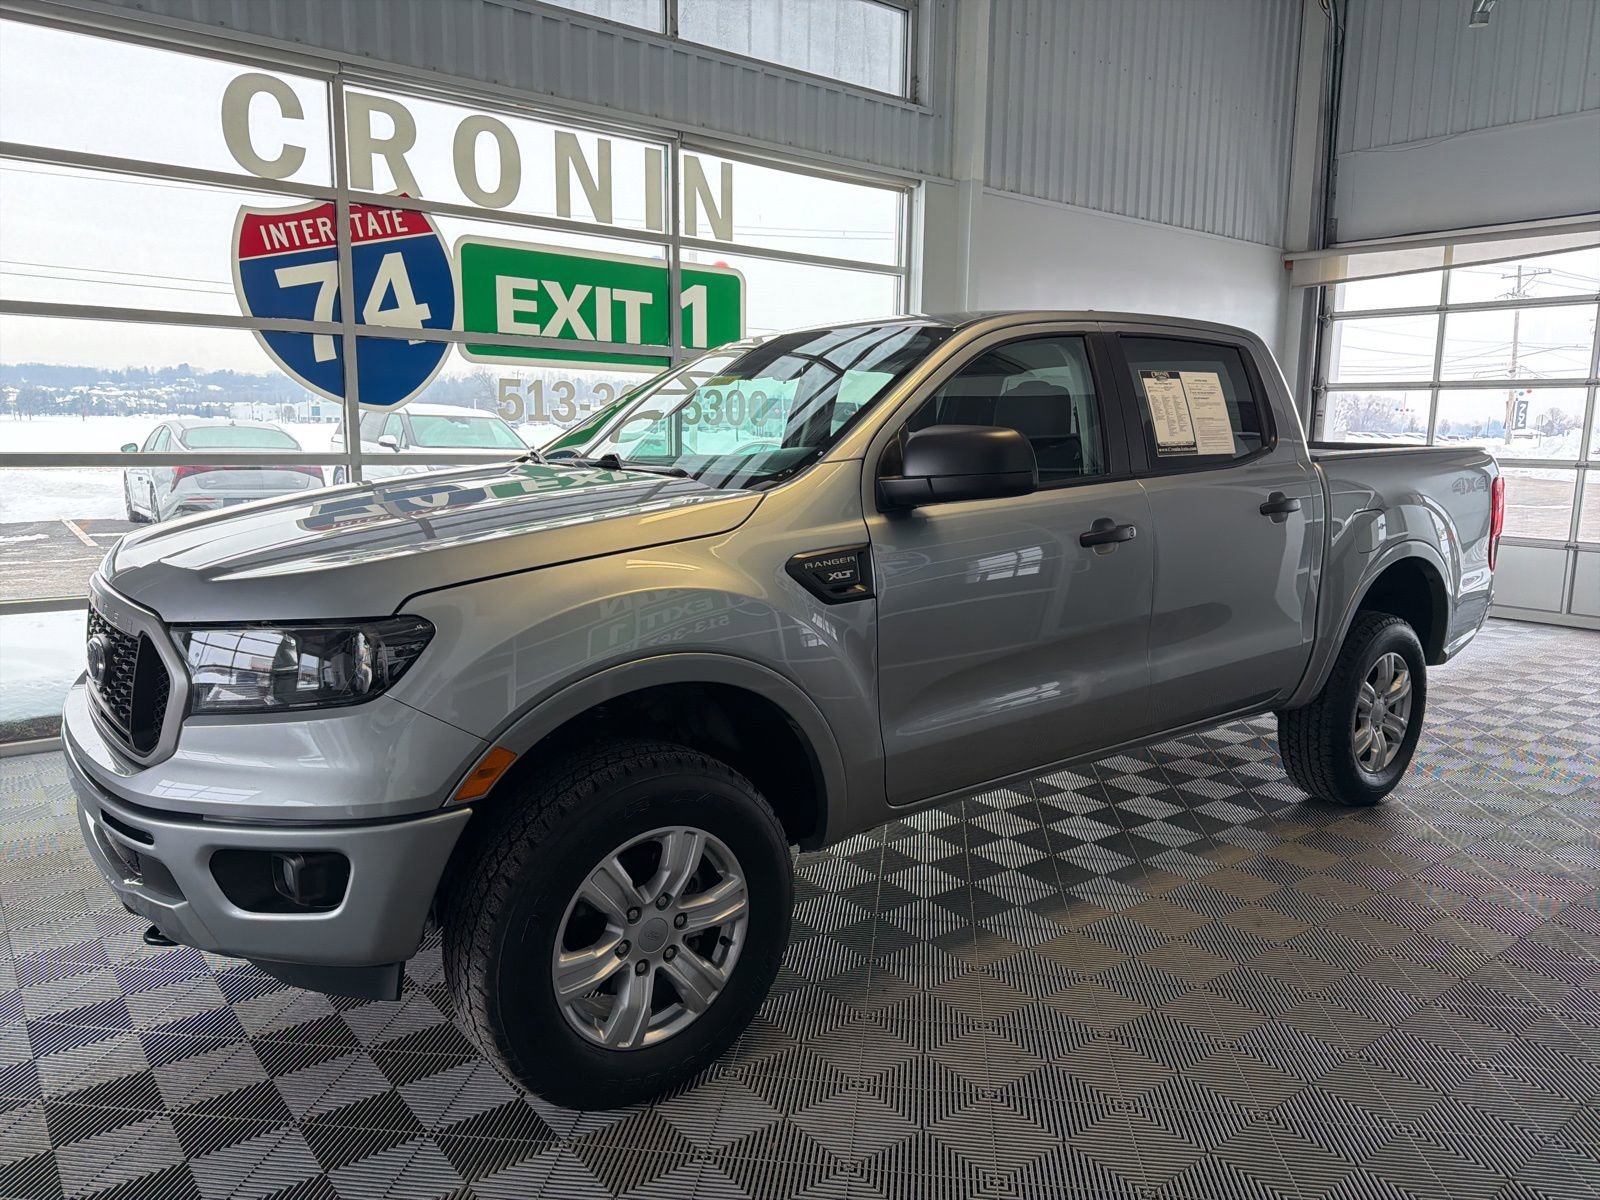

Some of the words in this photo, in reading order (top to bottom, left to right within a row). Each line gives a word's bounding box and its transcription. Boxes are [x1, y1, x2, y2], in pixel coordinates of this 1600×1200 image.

[221, 72, 733, 242] CRONIN
[260, 209, 409, 251] INTERTATE
[274, 252, 432, 363] 74
[496, 274, 653, 345] EXIT
[680, 285, 708, 349] 1
[804, 555, 856, 569] RANGER
[828, 569, 854, 581] XLT
